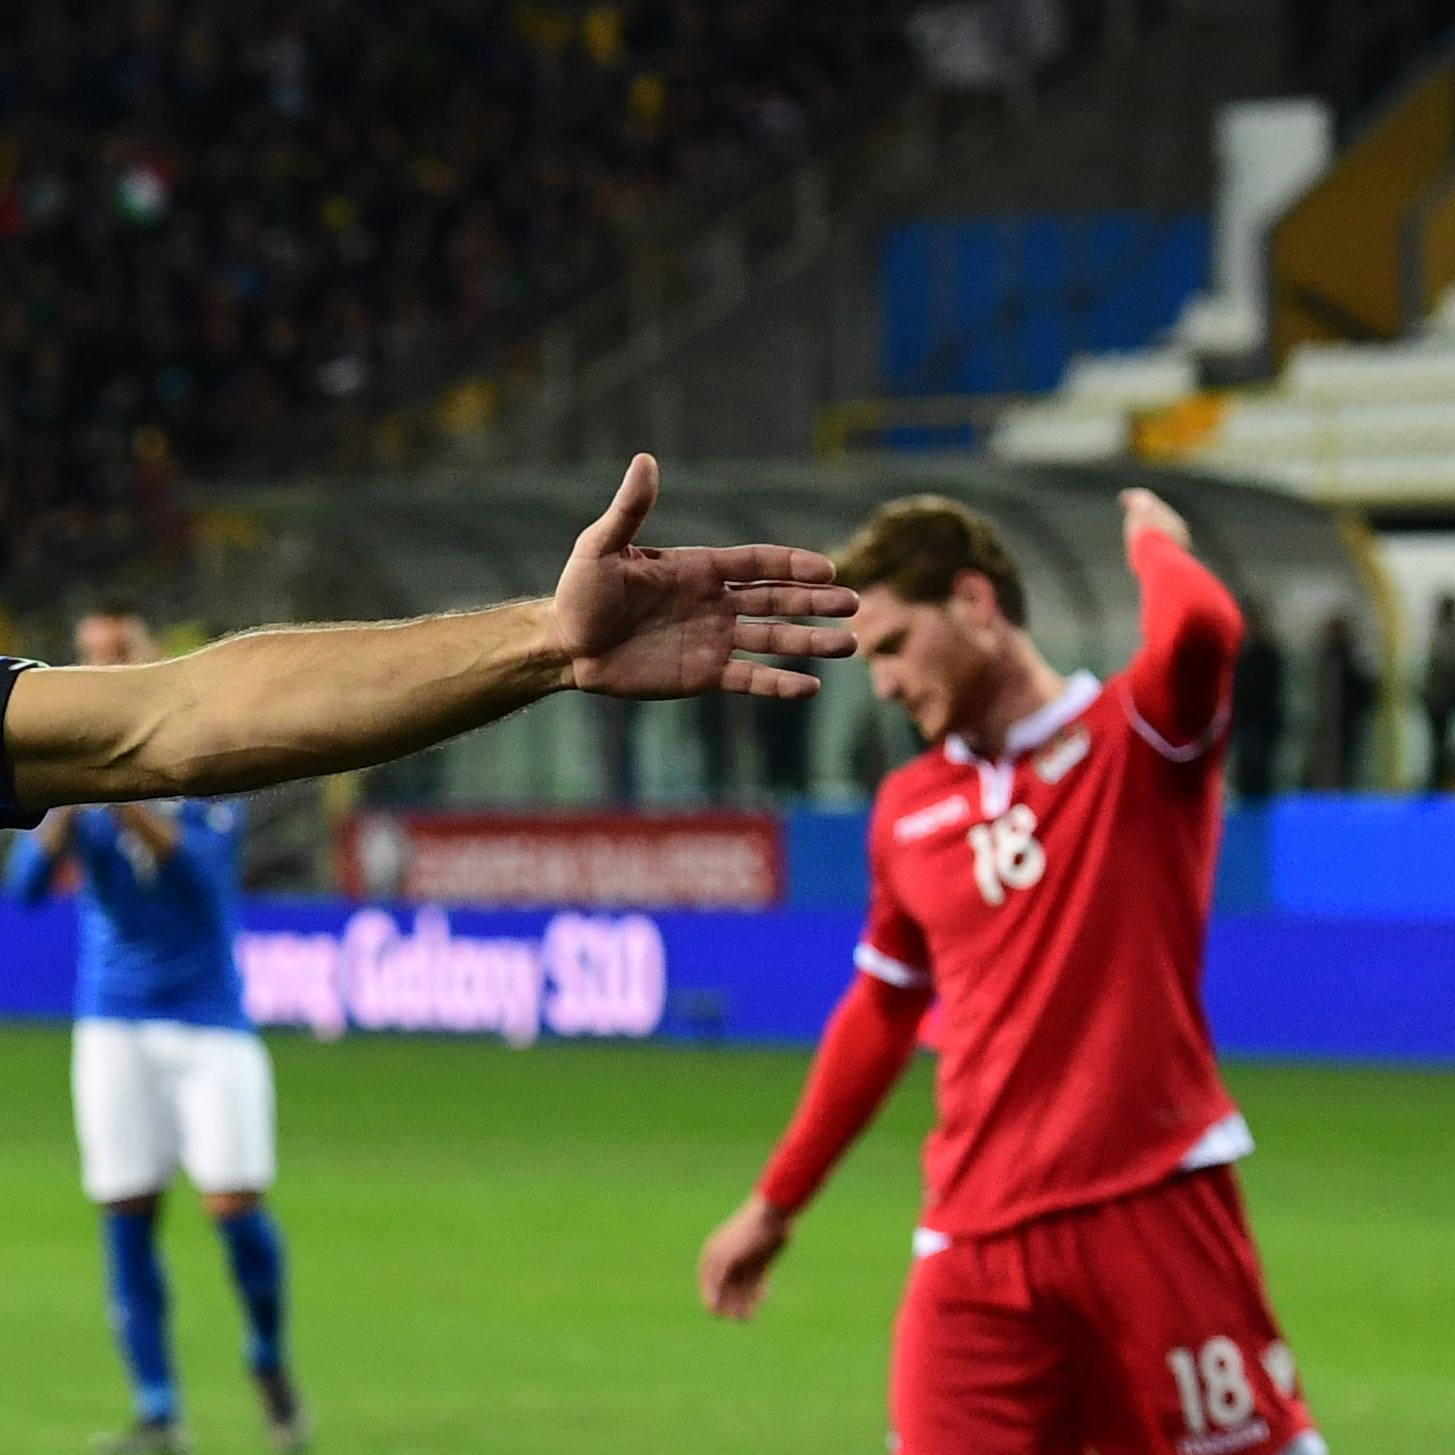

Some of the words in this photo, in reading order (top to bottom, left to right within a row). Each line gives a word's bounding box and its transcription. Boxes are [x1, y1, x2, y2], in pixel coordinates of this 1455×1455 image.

[344, 905, 540, 1048] Galaxy
[543, 911, 668, 1037] S10
[1165, 1334, 1255, 1437] 18
